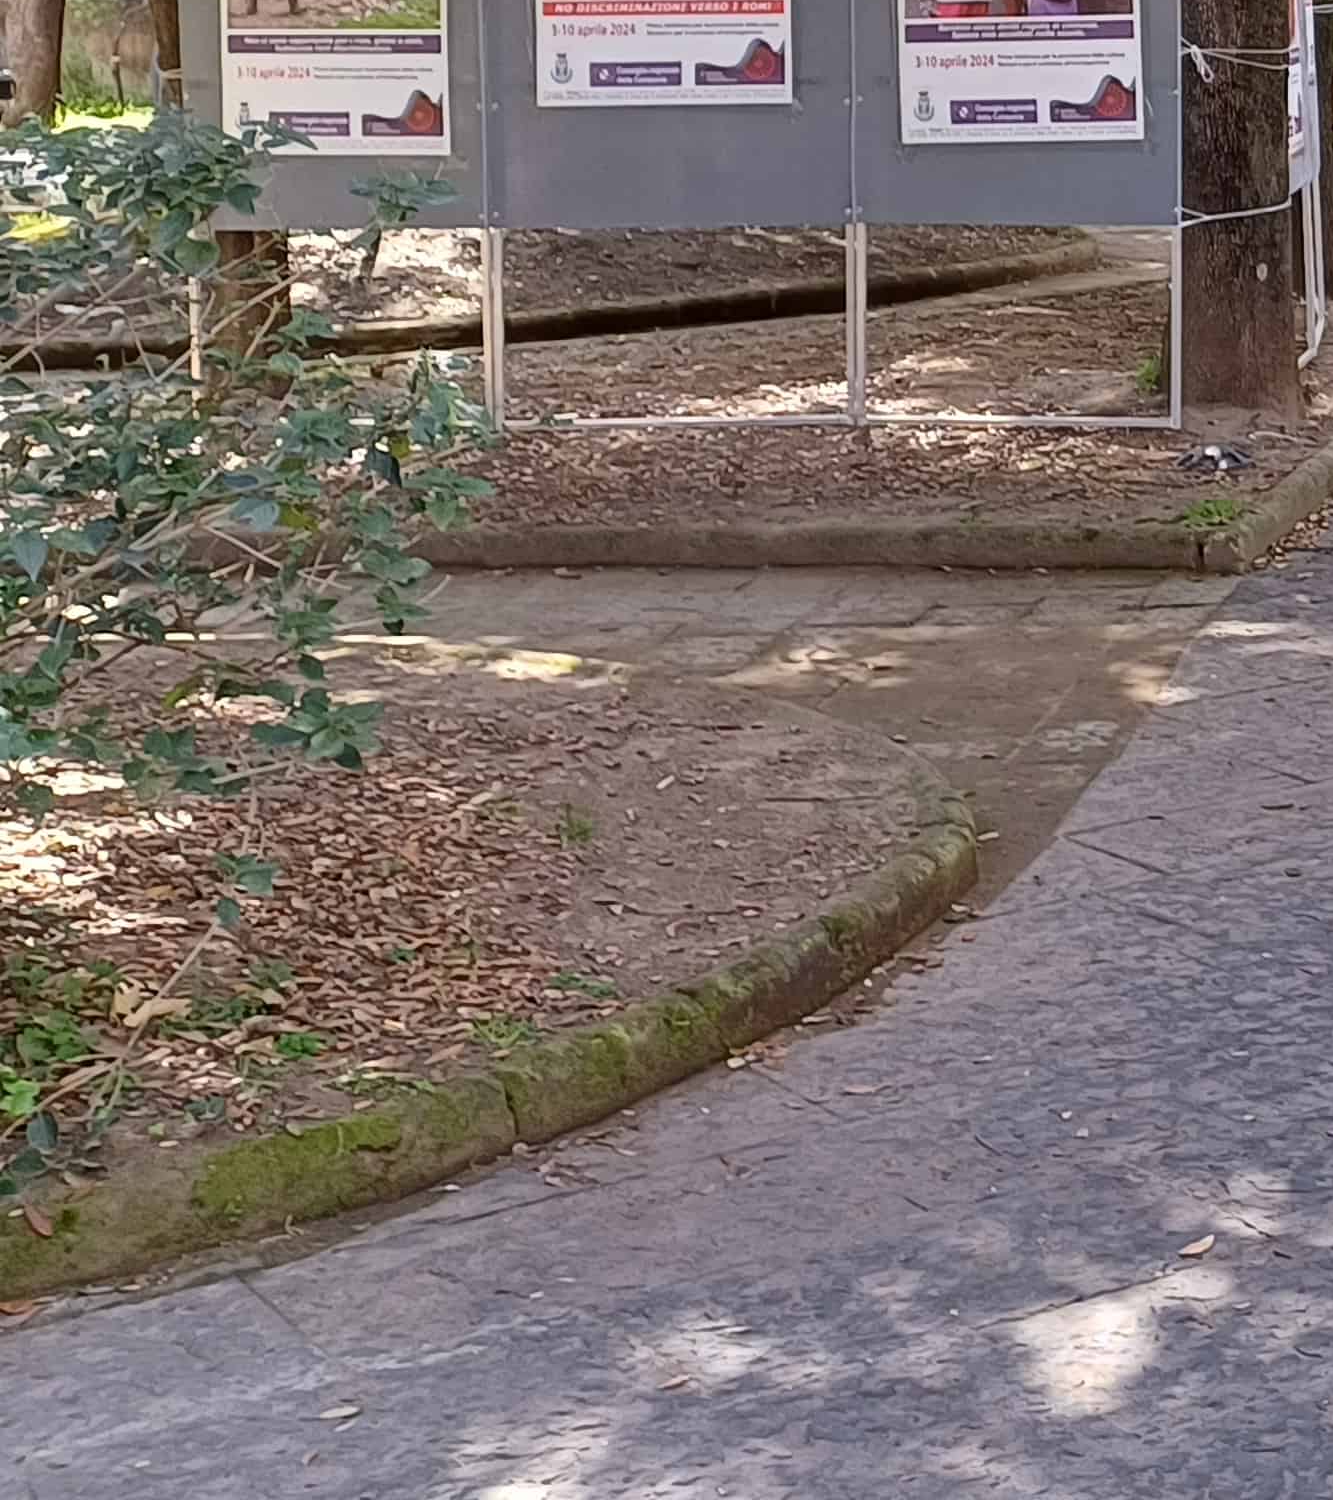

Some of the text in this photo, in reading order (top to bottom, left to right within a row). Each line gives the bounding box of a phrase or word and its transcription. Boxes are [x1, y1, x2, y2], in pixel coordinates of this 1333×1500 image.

[554, 3, 573, 14] NO
[690, 2, 729, 13] VERSO
[610, 23, 636, 37] 2024
[970, 54, 994, 68] 2024
